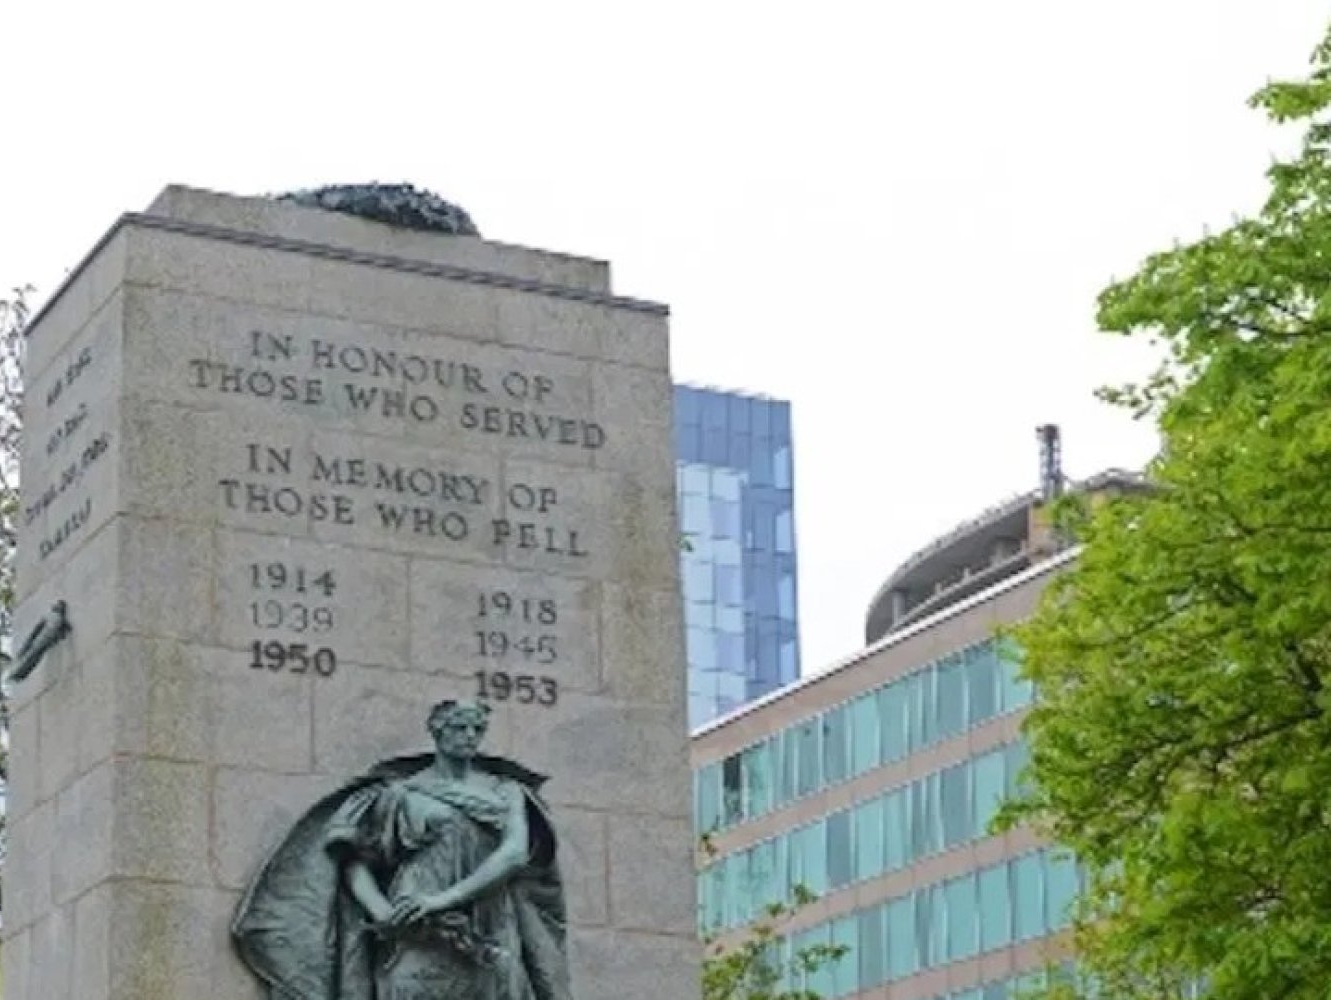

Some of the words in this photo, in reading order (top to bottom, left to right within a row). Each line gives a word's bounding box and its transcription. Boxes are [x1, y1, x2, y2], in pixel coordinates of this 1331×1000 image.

[251, 330, 294, 362] IN
[311, 340, 489, 394] HONOUR
[501, 370, 555, 403] OF
[188, 359, 323, 405] THOSE
[343, 383, 438, 422] WHO
[460, 403, 606, 449] SERVED
[219, 479, 356, 526] THOSE
[374, 502, 469, 541] WHO
[246, 443, 293, 475] IN
[311, 452, 490, 505] MEMORY
[508, 482, 558, 513] OF
[250, 562, 337, 596] 1914
[476, 591, 557, 625] 1918
[250, 599, 334, 633] 1939
[474, 630, 558, 665] 1945
[249, 639, 337, 678] 1950
[473, 669, 558, 706] 1953
